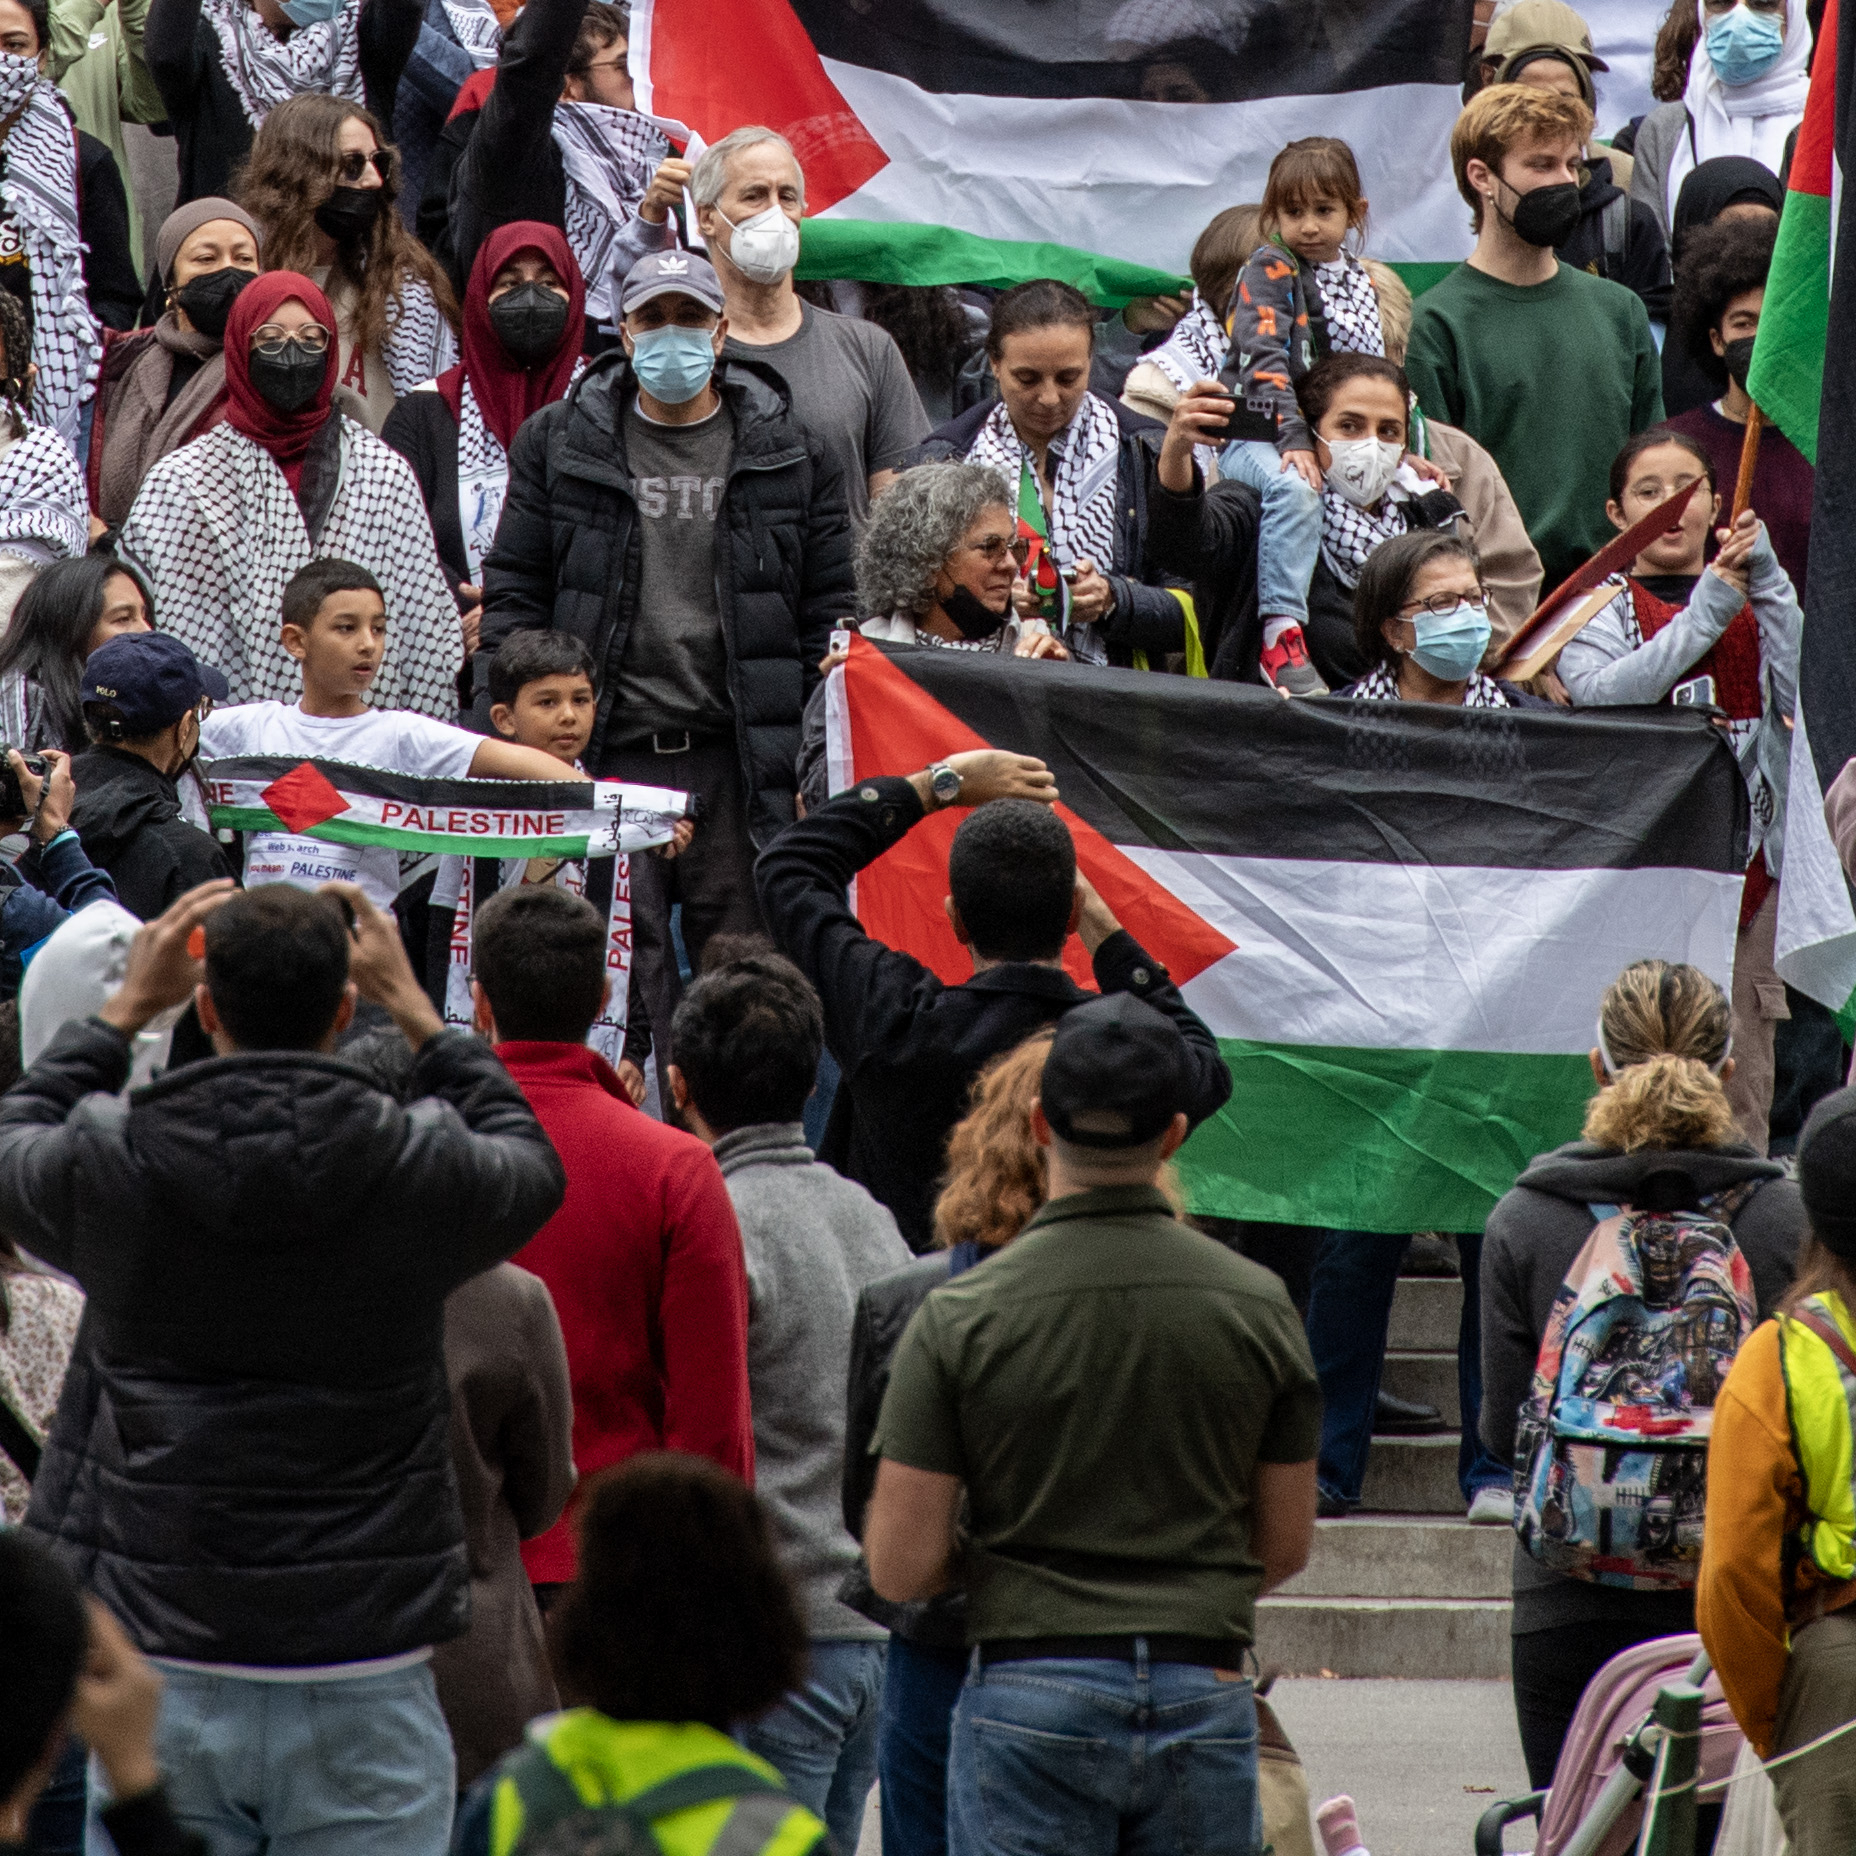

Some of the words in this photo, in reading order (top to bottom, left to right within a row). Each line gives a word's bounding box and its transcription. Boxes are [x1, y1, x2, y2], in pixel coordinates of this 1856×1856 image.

[95, 685, 118, 699] POLO
[380, 803, 565, 835] PALESTINE
[290, 861, 357, 882] PALESTINE
